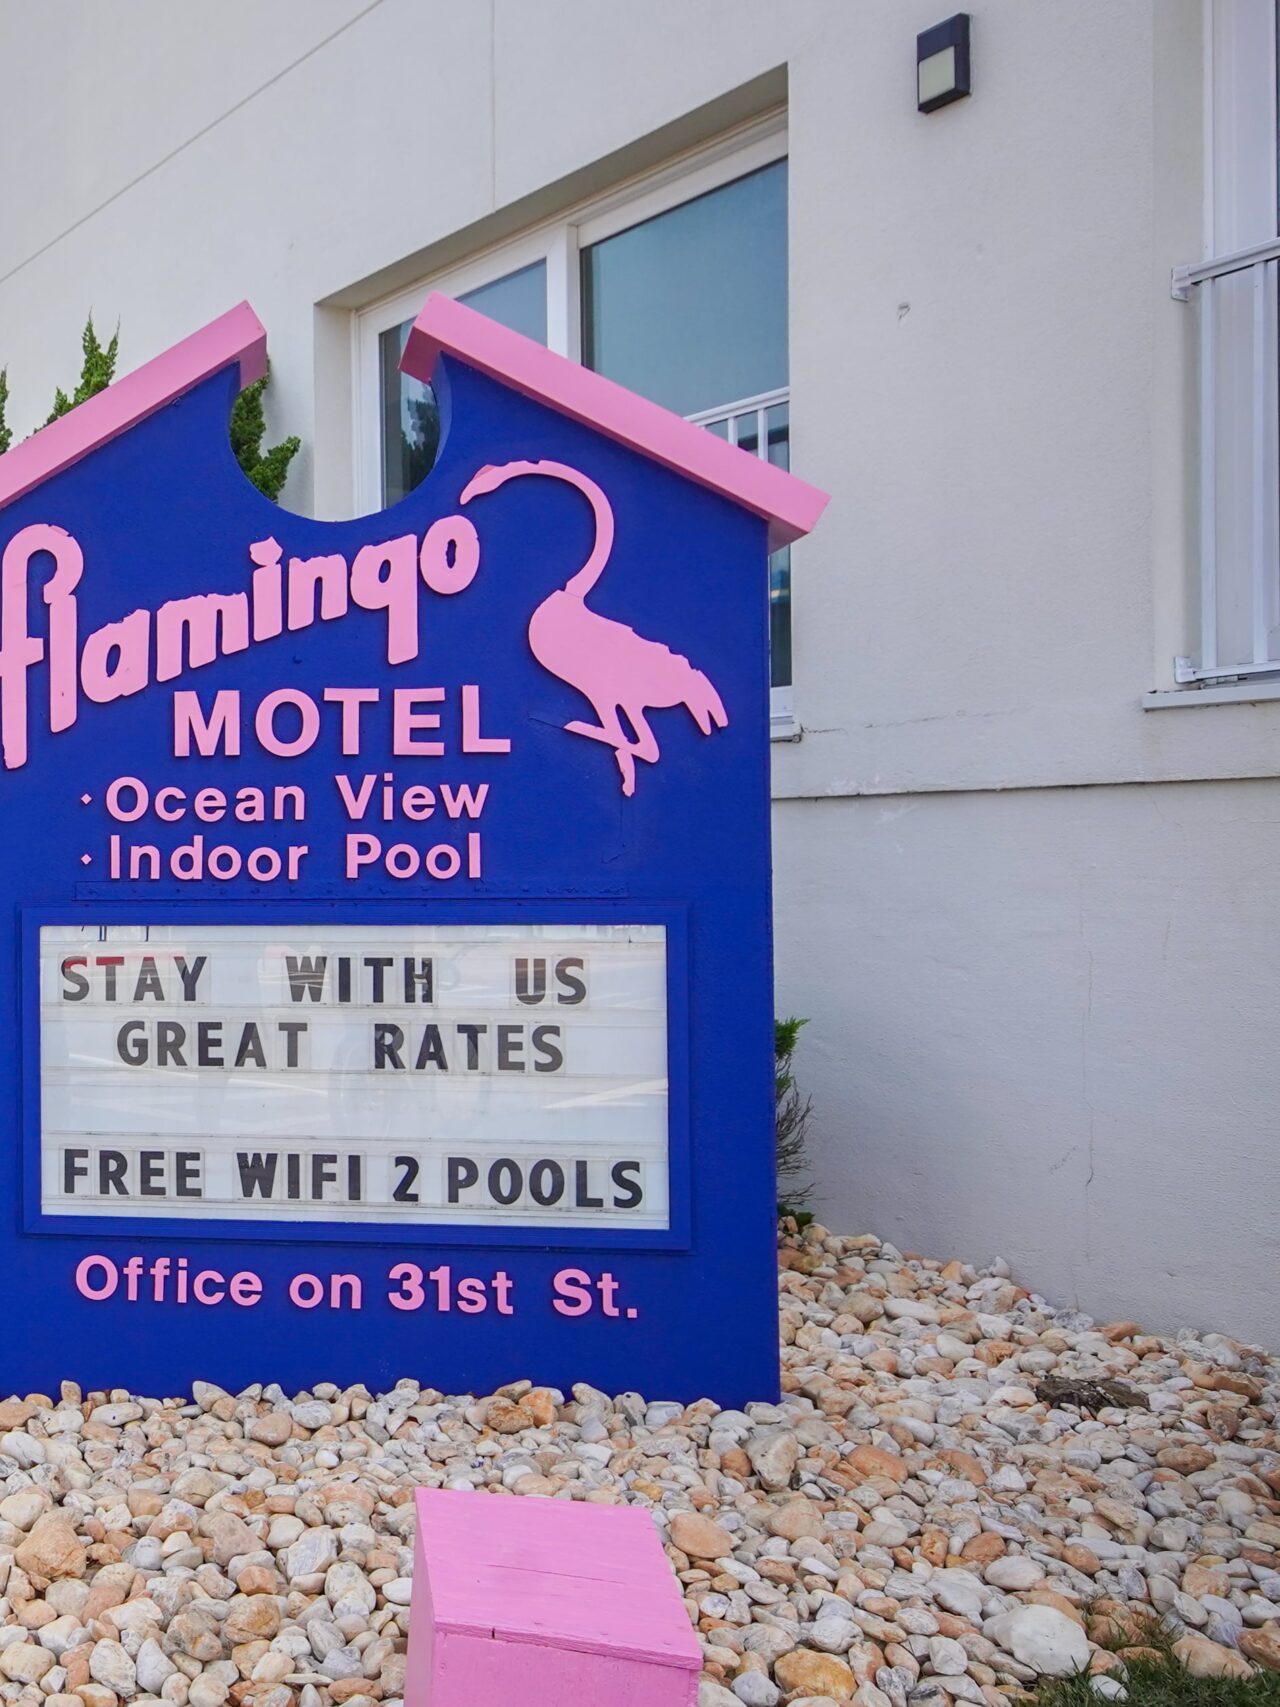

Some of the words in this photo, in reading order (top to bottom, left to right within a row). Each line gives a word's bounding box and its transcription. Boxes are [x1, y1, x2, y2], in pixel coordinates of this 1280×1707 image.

[174, 684, 511, 757] MOTEL
[106, 775, 305, 822] Ocean
[335, 773, 489, 821] View
[110, 834, 308, 881] Indoor
[346, 832, 481, 879] Pool
[61, 956, 208, 1002] STAY
[286, 956, 434, 1004] WITH
[515, 957, 587, 1006] US
[117, 1020, 308, 1068] GREAT
[374, 1023, 564, 1073] RATES
[63, 1148, 203, 1197] FREE
[236, 1152, 362, 1201] WIFI
[392, 1155, 420, 1203] 2
[448, 1157, 643, 1209] POOLS
[75, 1254, 263, 1306] Office
[289, 1273, 362, 1309] on
[388, 1263, 514, 1315] 31st
[553, 1268, 638, 1319] St.
